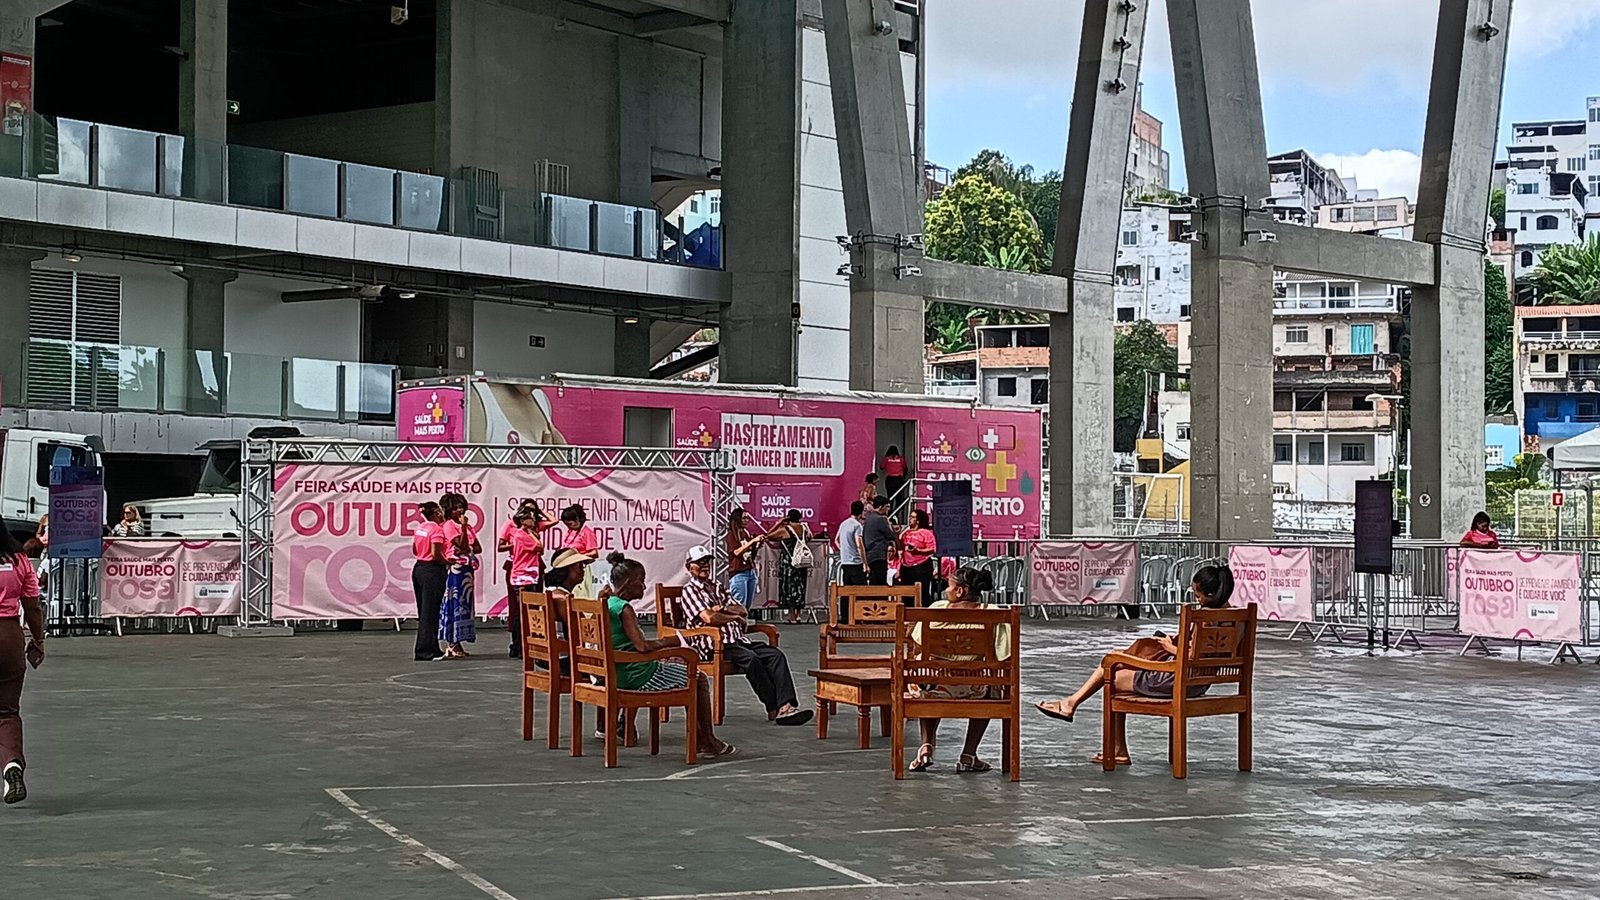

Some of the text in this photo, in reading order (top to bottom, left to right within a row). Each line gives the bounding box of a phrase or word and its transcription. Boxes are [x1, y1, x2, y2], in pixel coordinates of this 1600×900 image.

[414, 425, 445, 436] MAIS PERTO
[724, 422, 833, 450] RASTREAMENTO
[676, 435, 699, 446] SAÚDE
[740, 446, 782, 468] CÂNCER
[784, 451, 798, 468] DE
[799, 451, 833, 469] MAMA
[921, 446, 940, 455] SAÚDE
[921, 455, 955, 464] MAIS PERTO
[294, 477, 483, 494] FEIRA SAÚDE MAIS PERTO
[54, 499, 98, 508] OUTUBRO
[761, 493, 791, 506] SAÚDE
[972, 497, 1025, 517] PERTO
[54, 509, 98, 522] rosa
[623, 495, 695, 522] TAMBÉM
[761, 507, 815, 518] MAIS PTO
[290, 501, 486, 537] OUTUBO
[596, 528, 615, 551] DE
[620, 523, 665, 551] VOCÊ
[106, 564, 176, 577] OUTUBRO
[1033, 561, 1080, 572] OUTUBRO
[288, 544, 484, 608] ros
[1033, 572, 1080, 591] rosa
[105, 579, 176, 600] rosa
[1464, 577, 1515, 593] OUTUBRO
[1464, 593, 1515, 620] rosa
